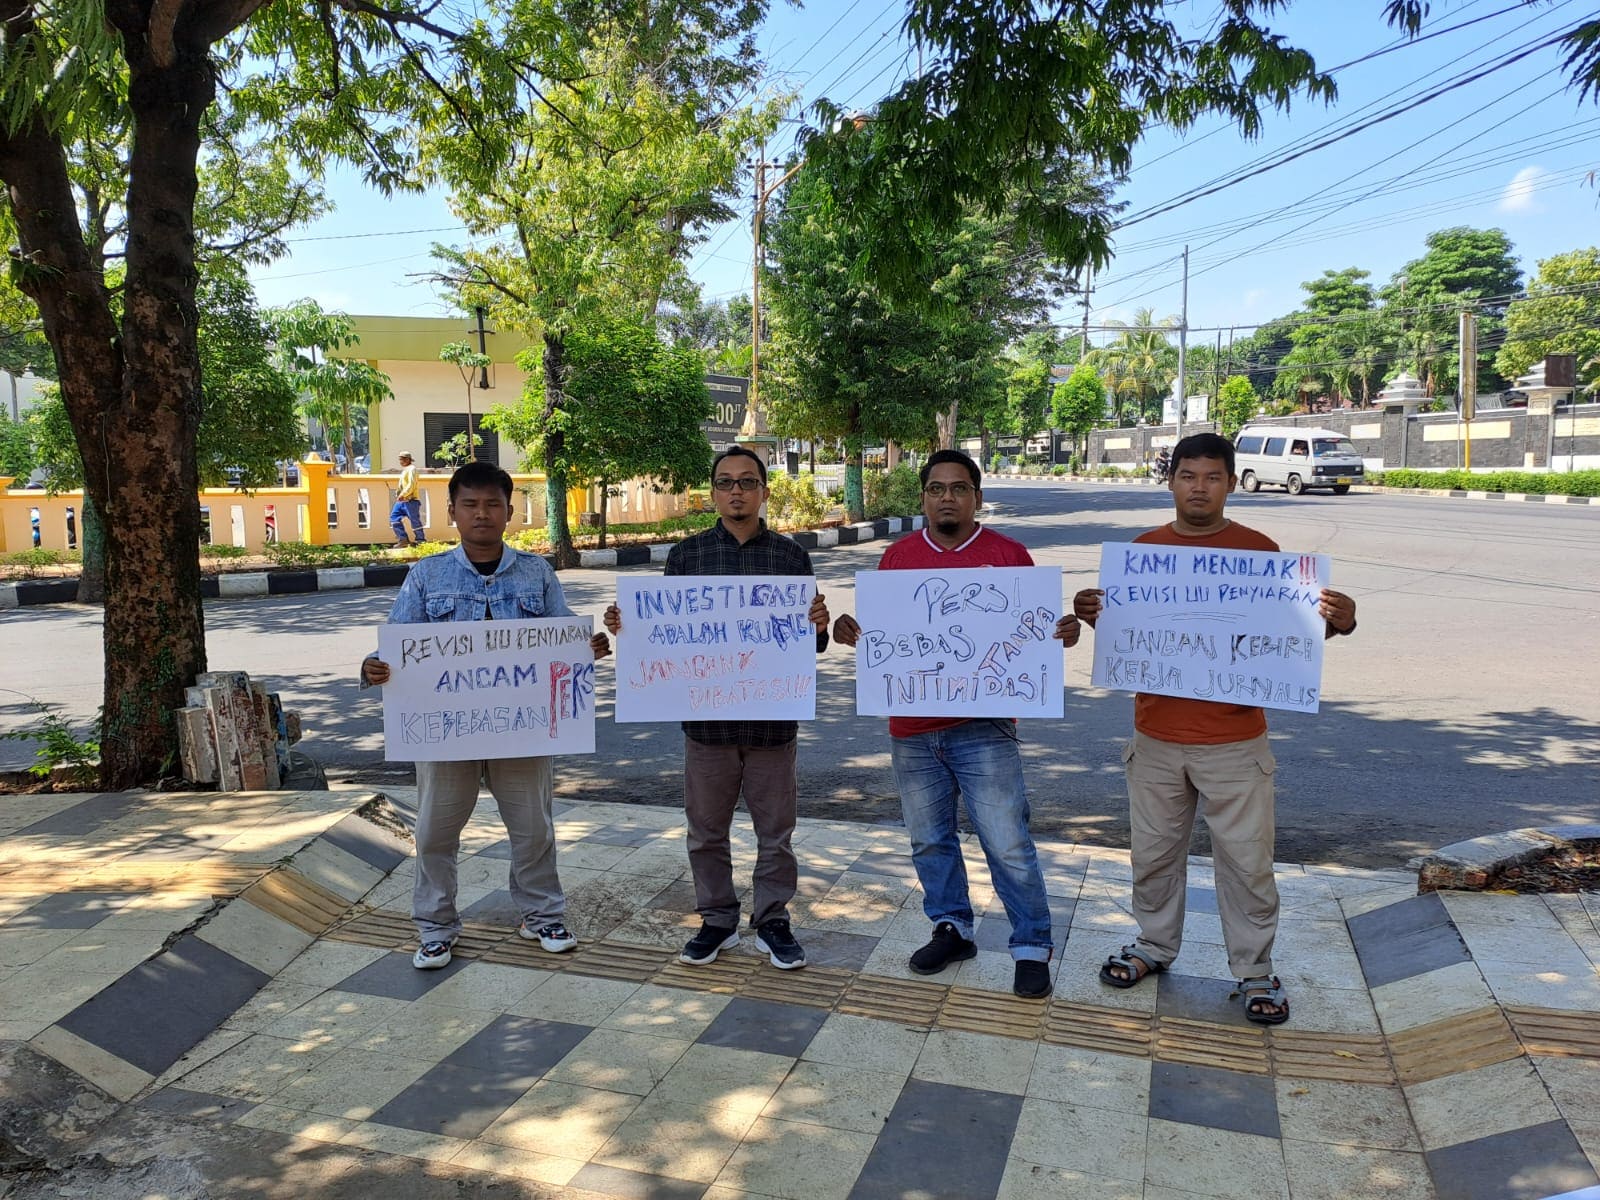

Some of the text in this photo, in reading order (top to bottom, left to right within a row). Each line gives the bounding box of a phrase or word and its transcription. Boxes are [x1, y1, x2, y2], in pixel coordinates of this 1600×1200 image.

[1124, 550, 1177, 576] KAMI
[635, 584, 807, 619] INVESTIGASI
[1105, 584, 1321, 608] REVISI UU PENYIARAN
[401, 624, 593, 669] REVISI UU PENYIARAN
[648, 621, 727, 645] ADALAH
[861, 606, 1055, 677] BEBAS TANPA
[1114, 627, 1313, 665] JANGAN KEBIRI
[434, 661, 595, 739] ANCAM PERS
[1105, 656, 1317, 706] KERJA JURNALIS
[401, 706, 549, 744] KEBEBASAN
